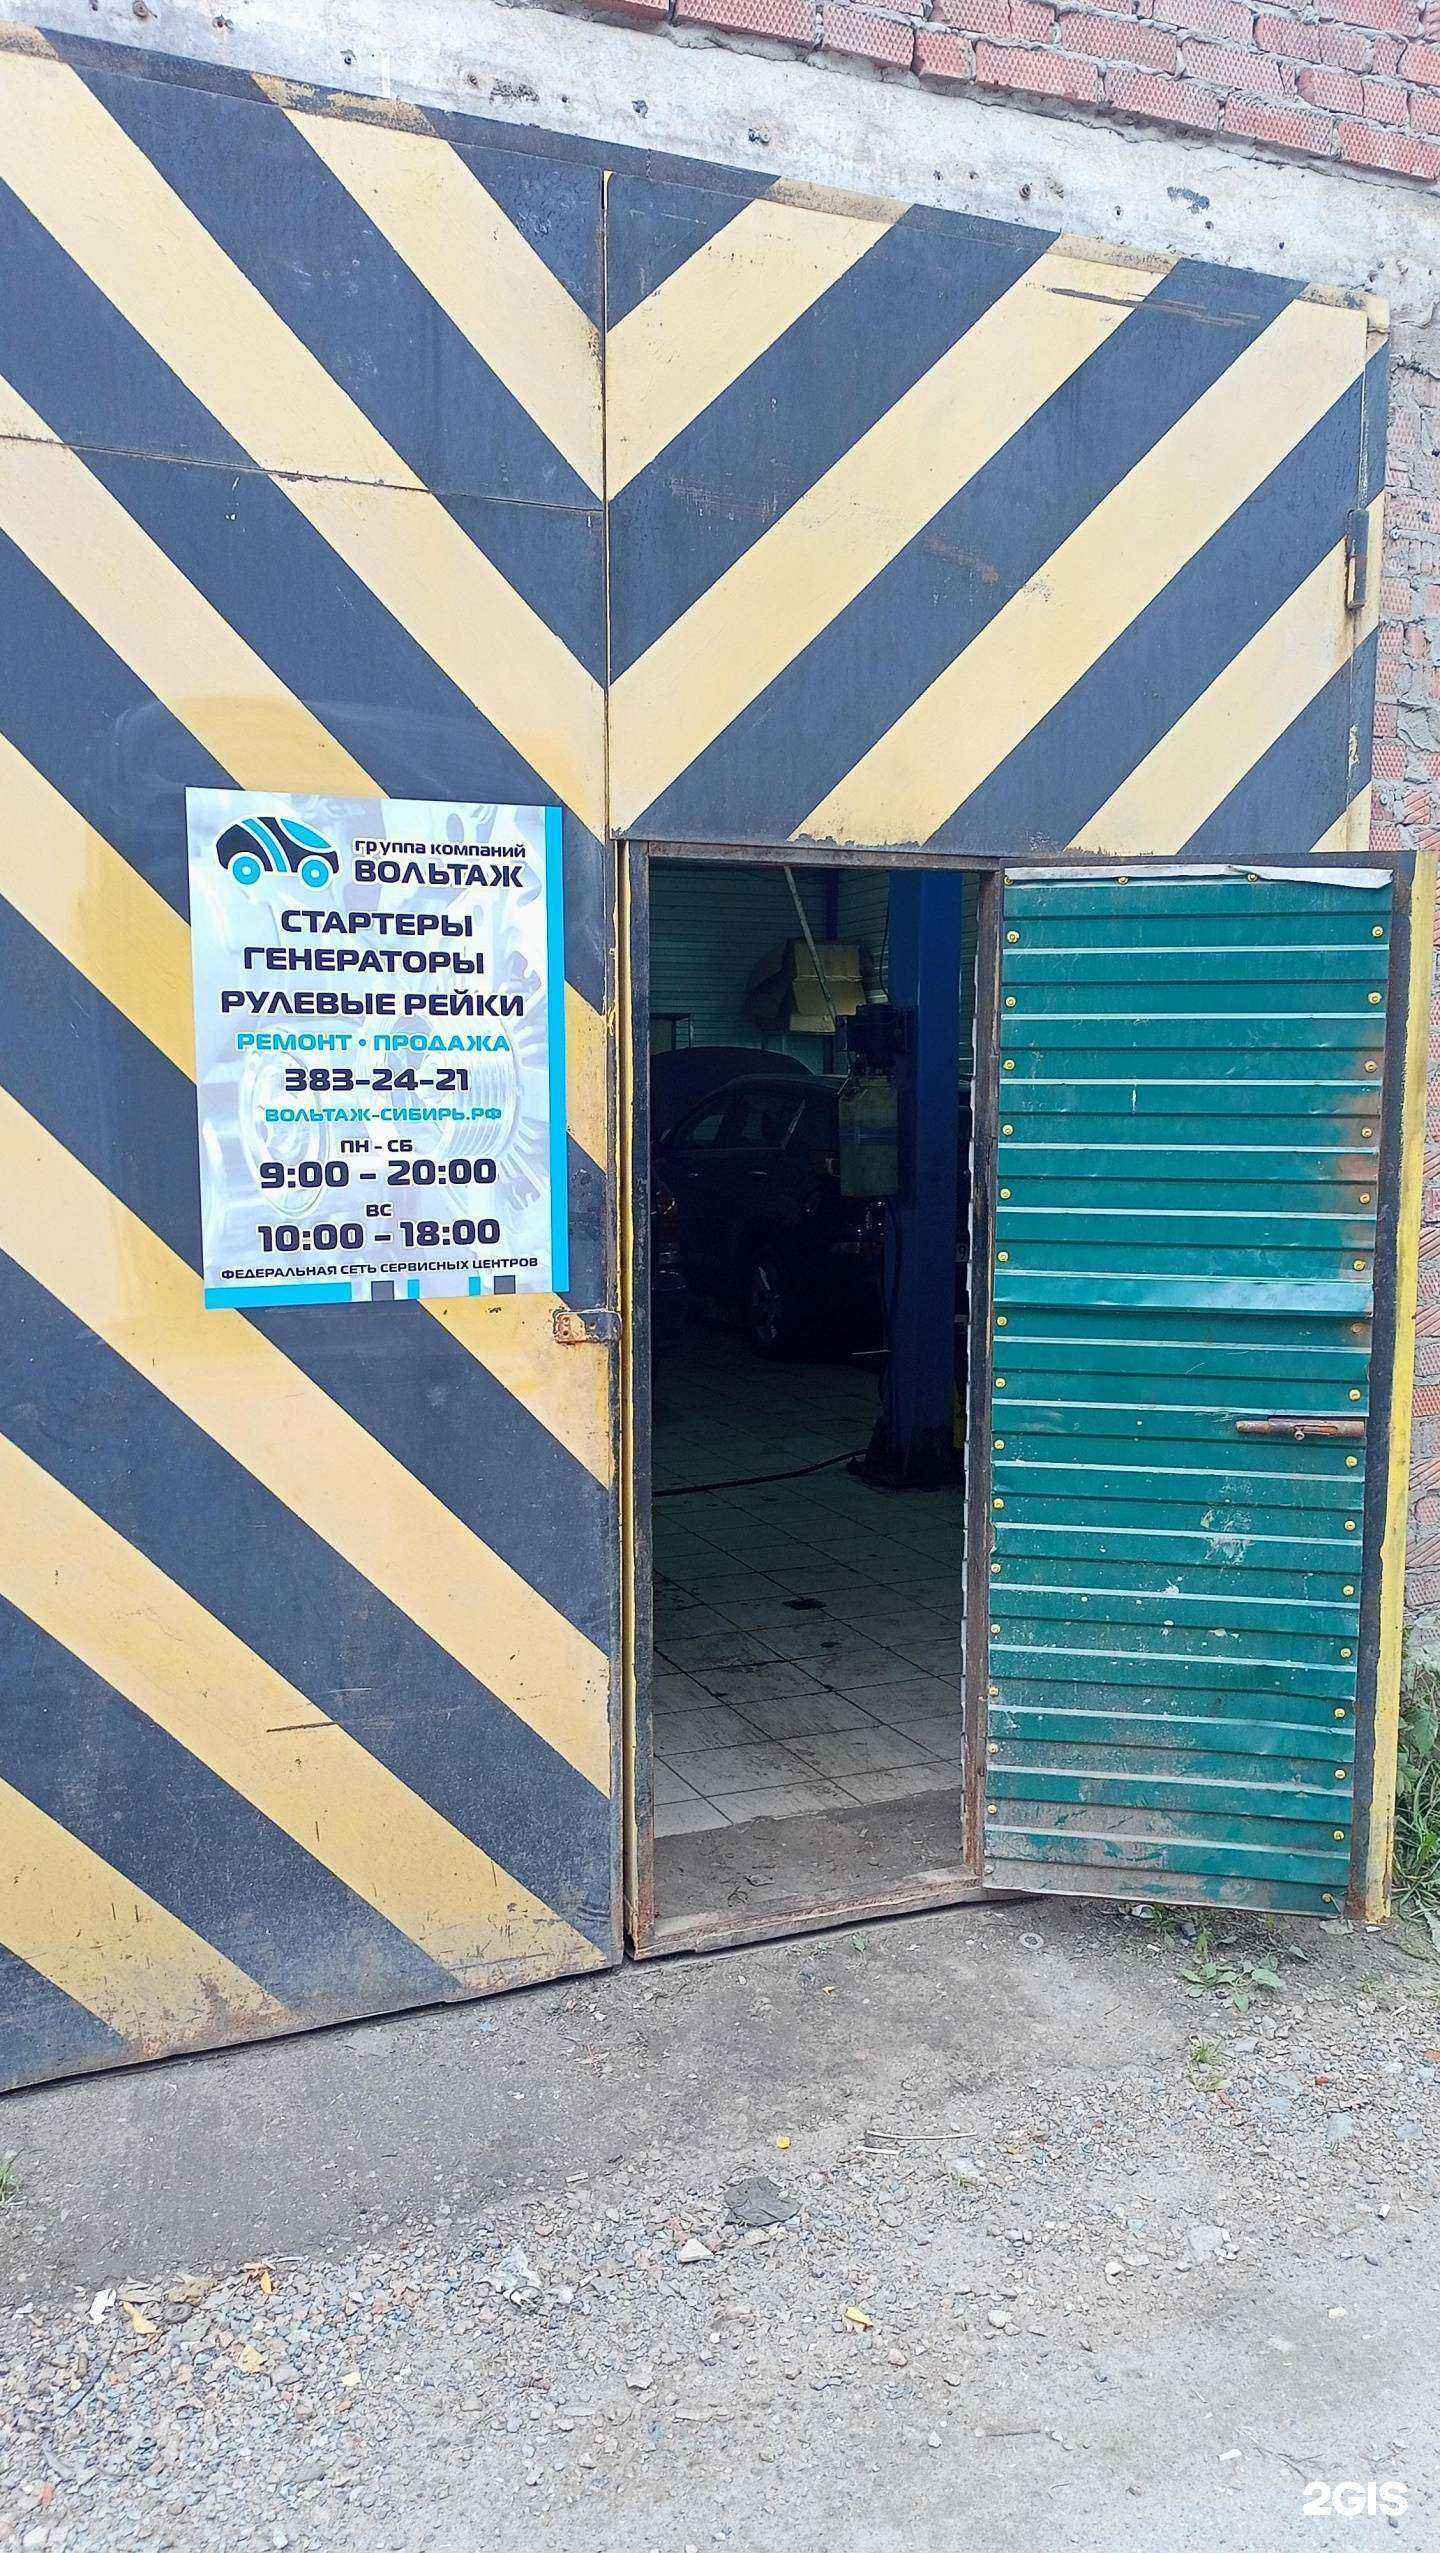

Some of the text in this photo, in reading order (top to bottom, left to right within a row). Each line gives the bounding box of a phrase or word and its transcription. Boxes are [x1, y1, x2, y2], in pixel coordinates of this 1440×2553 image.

[430, 843, 526, 858] компаний
[355, 860, 524, 888] ВОЛЬТАЖ
[281, 910, 472, 937] СТАРТЕРЫ
[244, 947, 484, 974] ГЕНЕРАТОРЫ
[221, 989, 524, 1016] РУЛЕВЫЕ РЕЙКИ
[237, 1033, 510, 1052] РЕМОНТ ПРОДАЖА
[285, 1068, 469, 1092] 383-24-21
[265, 1108, 501, 1122] ВОЛЬТАЖ-СИБИРЬ.РФ
[341, 1139, 370, 1153] ПН
[387, 1139, 413, 1152] СБ
[260, 1161, 349, 1189] 9:00
[387, 1159, 497, 1186] 20:00
[365, 1204, 392, 1217] ВС
[258, 1223, 364, 1252] 10:00
[400, 1219, 501, 1247] 18:00
[221, 1257, 538, 1279] ФЕДЕРАЛЬНАЯ СЕТЬ СЕРВИСНЫХ ЦЕНТРОВ
